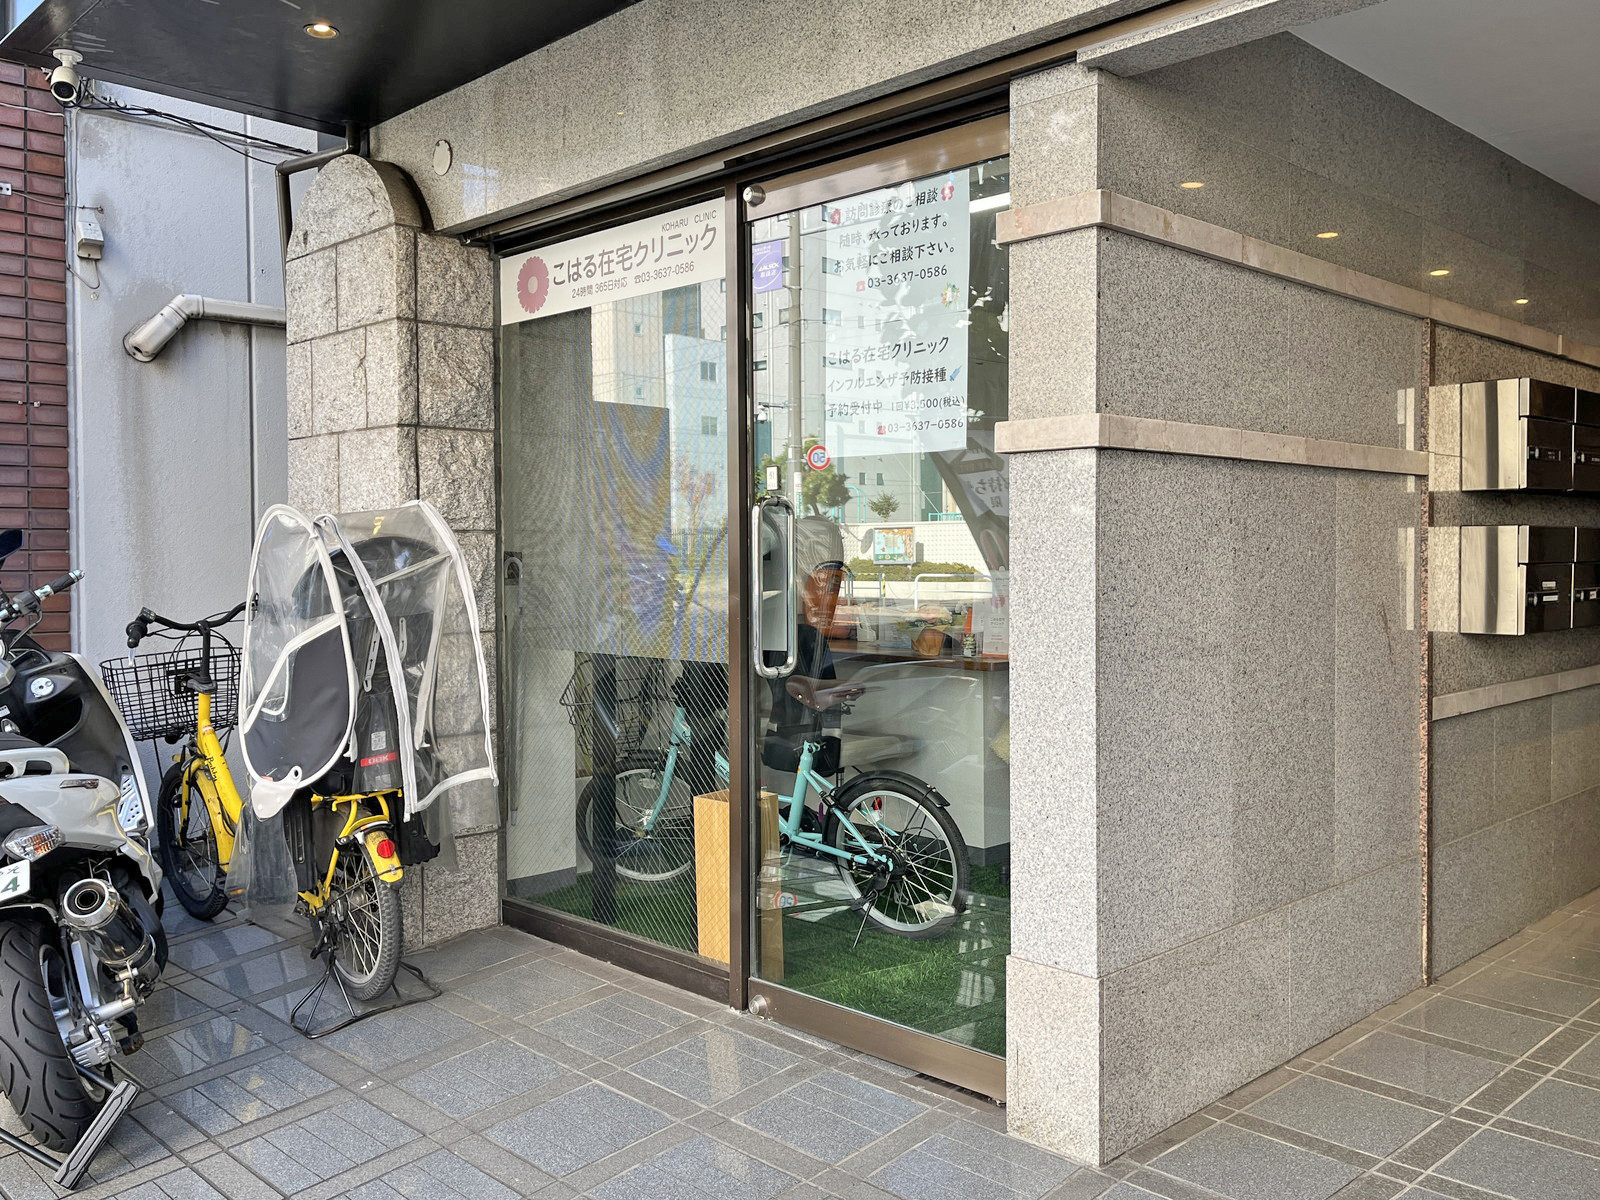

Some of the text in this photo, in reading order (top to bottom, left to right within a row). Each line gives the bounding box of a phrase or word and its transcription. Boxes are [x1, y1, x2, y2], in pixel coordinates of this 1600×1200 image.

[661, 209, 717, 233] KOHARU CLINIC
[552, 223, 718, 287] こはる在宅クリニック
[834, 241, 955, 274] お気軽にご相談下さい。
[641, 261, 695, 284] 03-3637-0586
[867, 265, 948, 289] 03-3637-0586
[571, 277, 628, 299] 24時間 365日対応
[828, 336, 949, 366] こはる在宅クリニック
[827, 366, 947, 393] インフルエンザ予防接種
[827, 400, 883, 418] 予約受付中
[887, 419, 964, 433] 03-3637-0586
